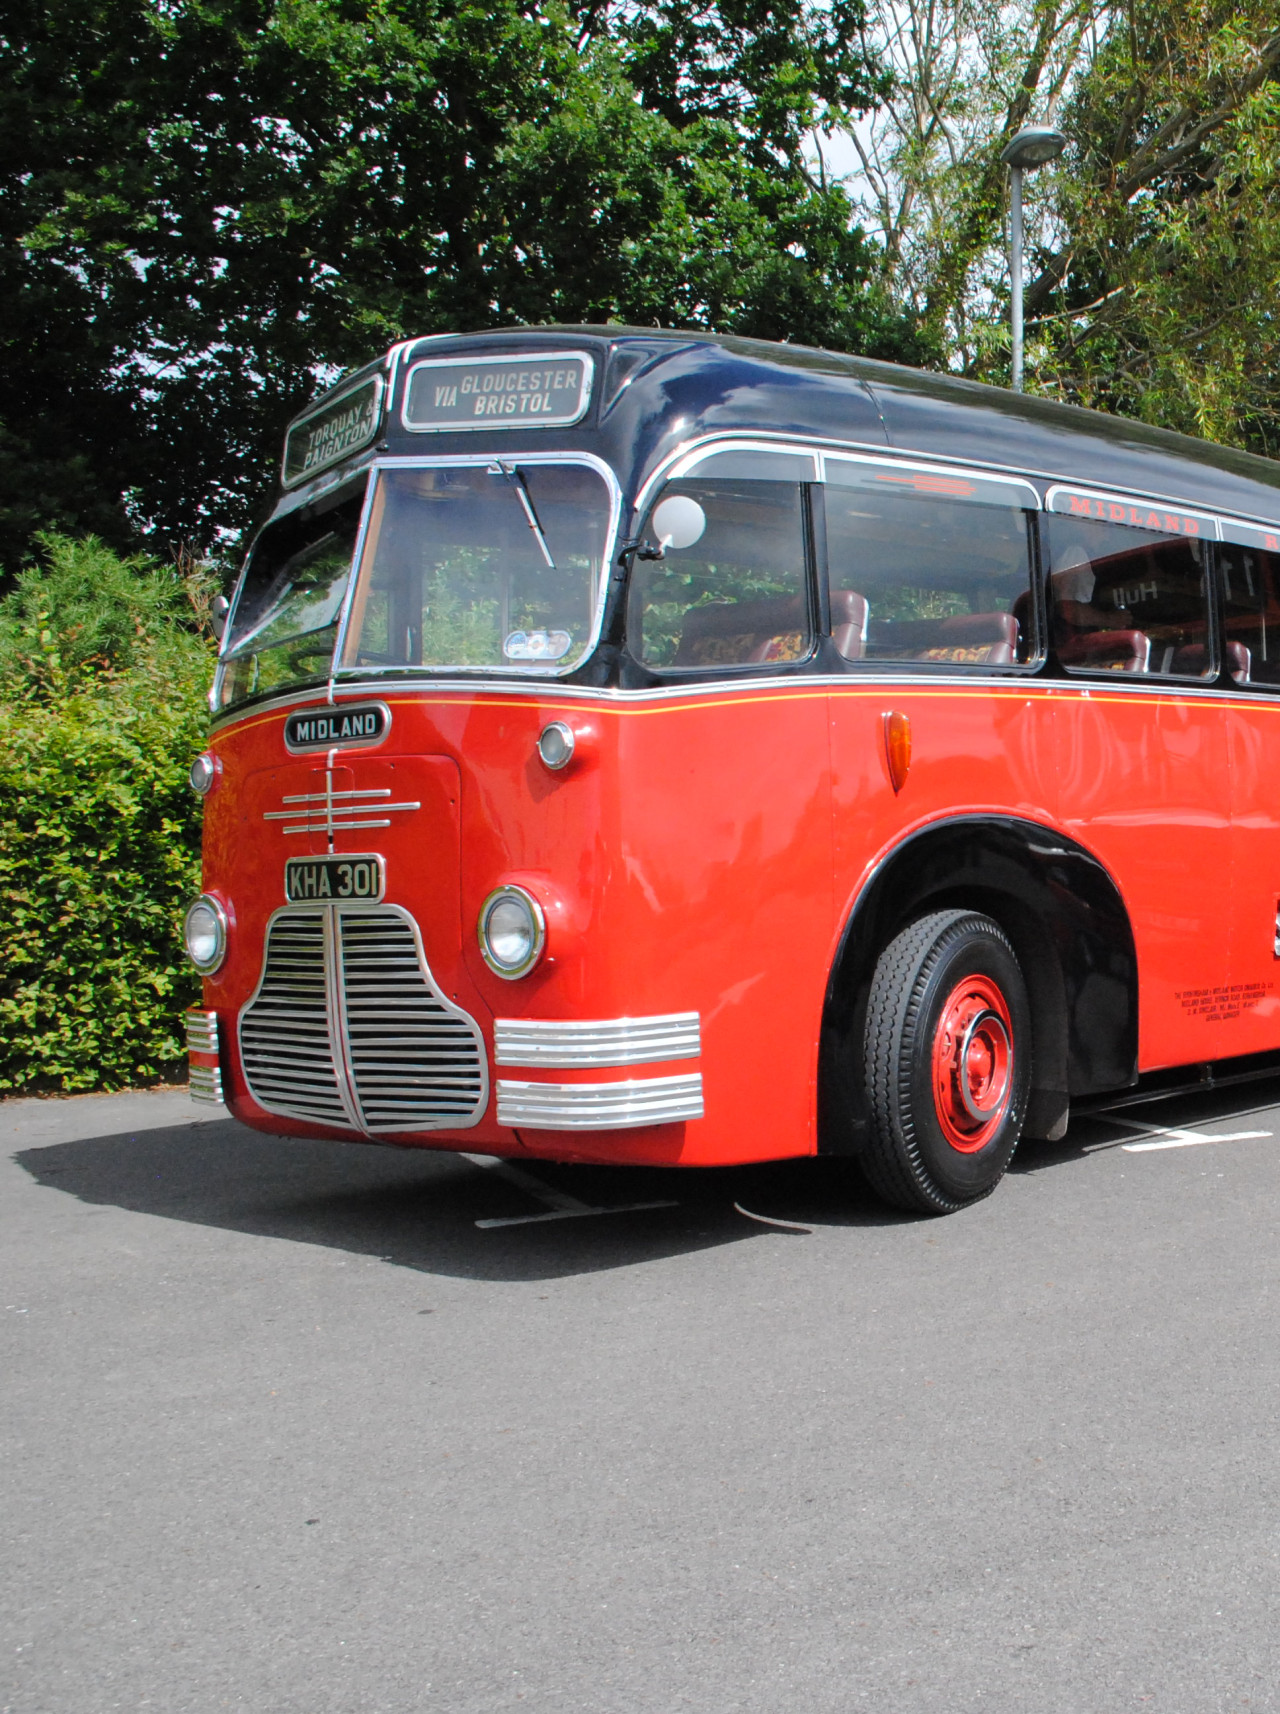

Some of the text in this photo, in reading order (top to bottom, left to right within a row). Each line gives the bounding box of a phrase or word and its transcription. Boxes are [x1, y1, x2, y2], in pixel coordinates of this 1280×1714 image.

[434, 386, 458, 407] VIA
[461, 370, 577, 394] GLOUCESTER
[474, 392, 552, 415] BRISTOL
[309, 404, 363, 450] TORQUAY
[303, 417, 371, 471] PAIGNTON
[1069, 496, 1199, 535] MIDLAND
[296, 713, 376, 742] MIDLAND
[289, 862, 379, 899] KHA 301
